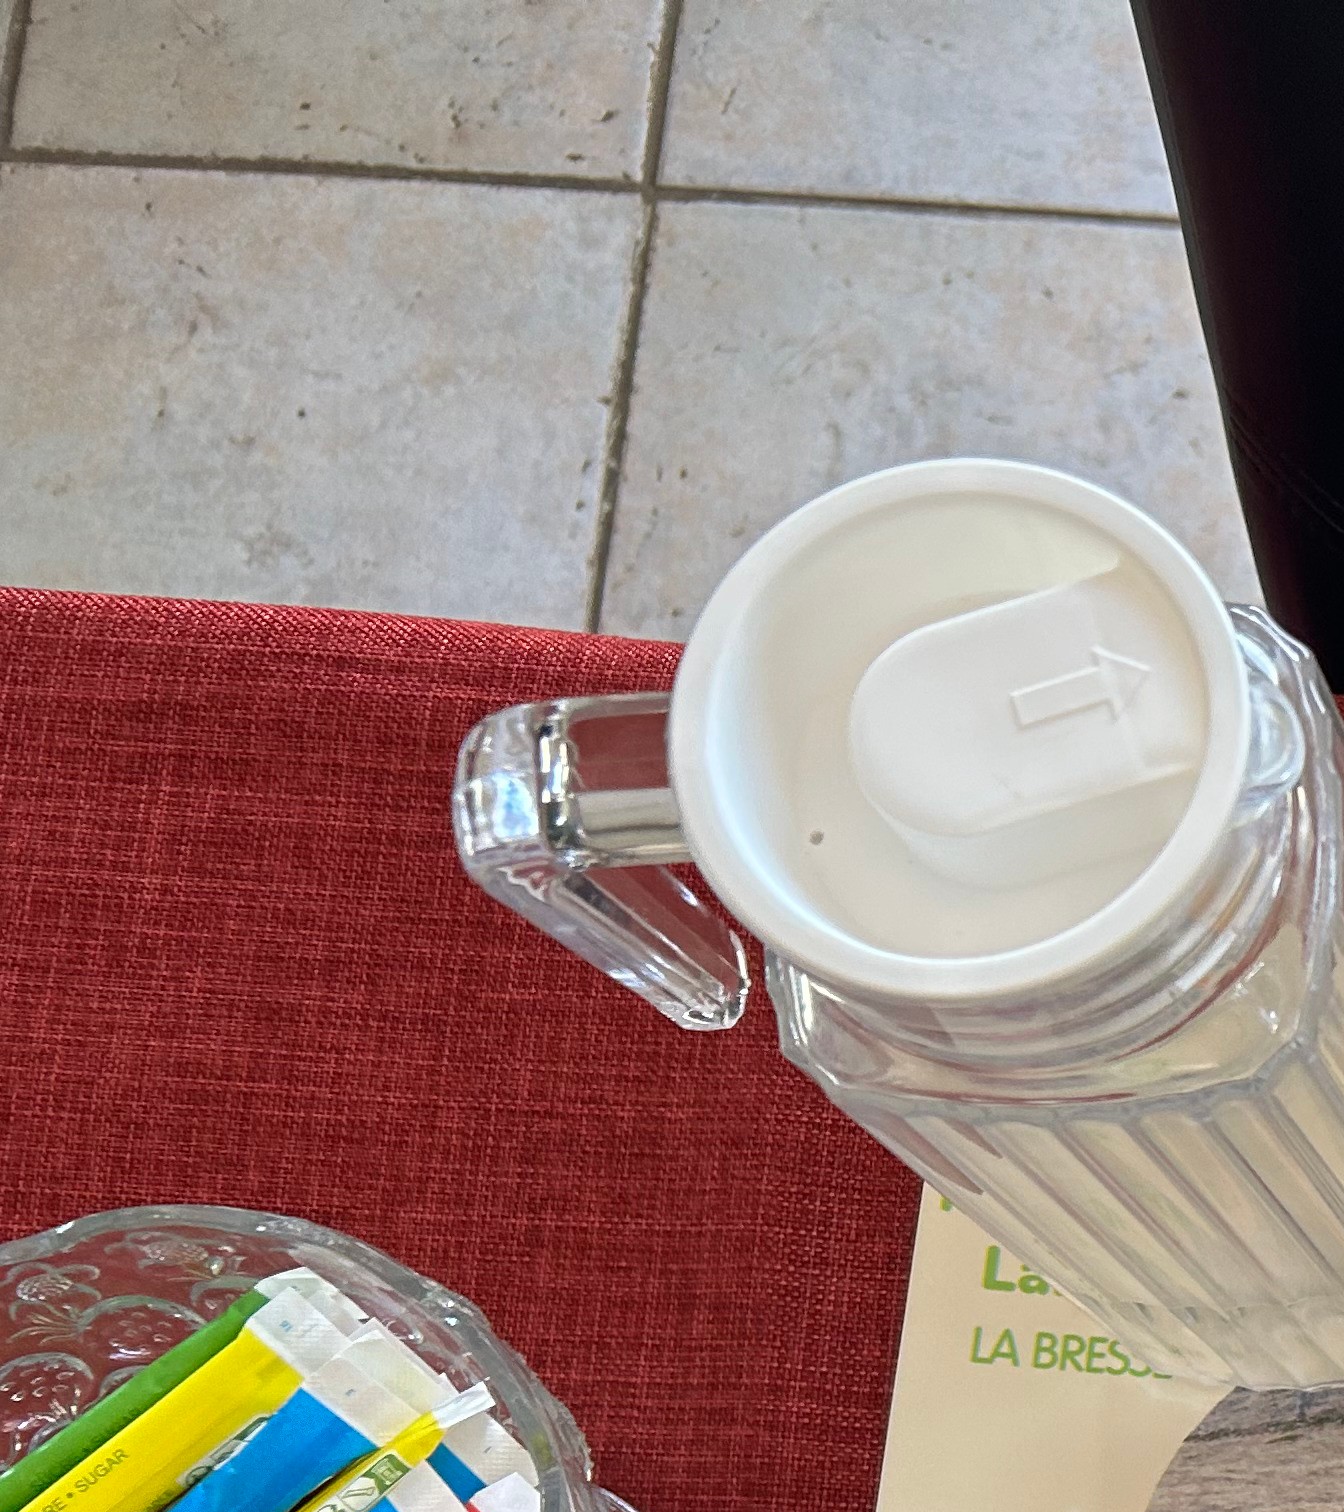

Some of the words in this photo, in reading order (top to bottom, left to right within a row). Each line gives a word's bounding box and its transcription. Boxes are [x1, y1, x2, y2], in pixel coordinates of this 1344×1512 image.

[970, 1327, 1020, 1367] LA
[1032, 1331, 1173, 1380] BRES
[74, 1448, 129, 1493] SUGAR
